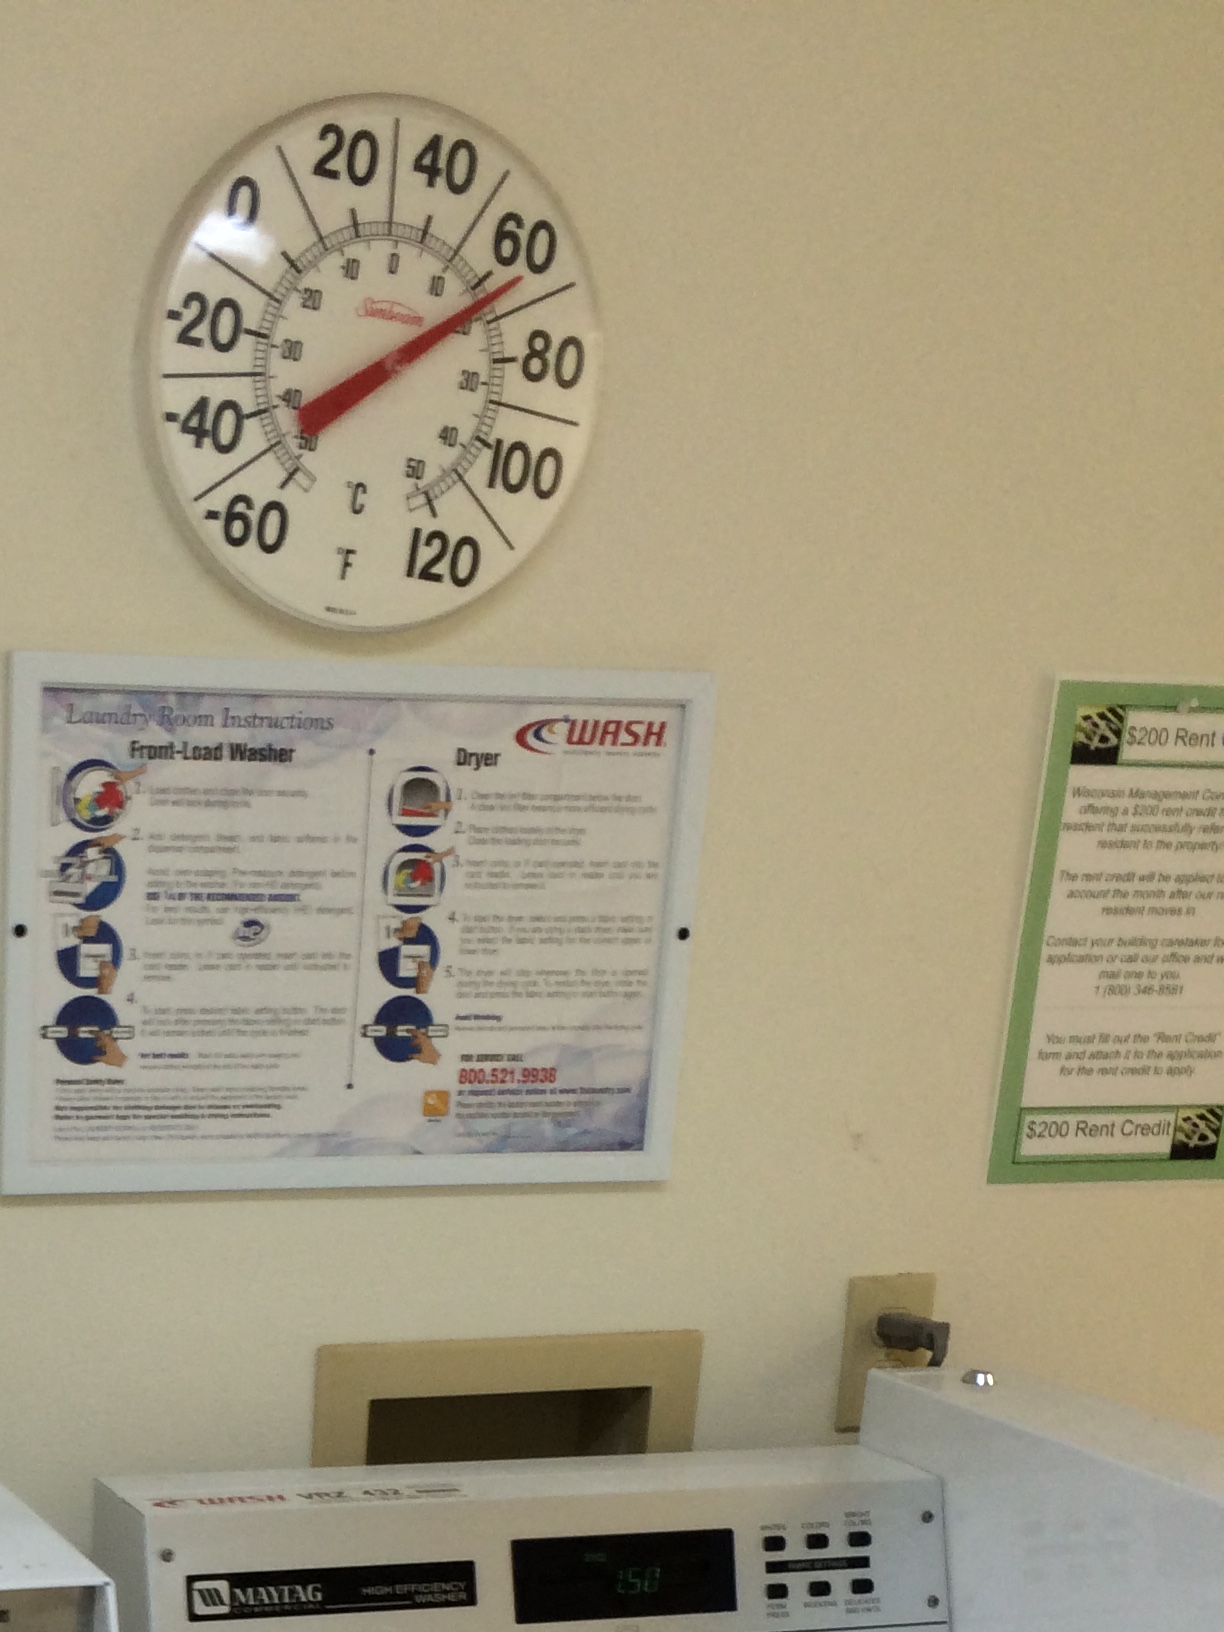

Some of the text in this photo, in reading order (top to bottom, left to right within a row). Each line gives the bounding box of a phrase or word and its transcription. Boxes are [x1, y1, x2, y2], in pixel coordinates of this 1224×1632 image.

[314, 123, 379, 187] 20
[414, 133, 477, 195] 40
[227, 175, 261, 230] 0
[493, 212, 557, 275] 60
[165, 290, 244, 353] -20
[521, 329, 586, 390] 80
[164, 395, 244, 454] -40
[487, 438, 564, 500] 100
[204, 492, 290, 555] -60
[407, 526, 482, 589] 120
[66, 702, 335, 732] Laundry Room Instructions
[566, 718, 666, 748] WASH
[1126, 725, 1216, 748] $200 Rent
[129, 739, 297, 763] Front-Load Washer
[455, 747, 502, 772] Dryer
[458, 1067, 558, 1085] 800.521.9938
[1026, 1118, 1172, 1140] $200 Rent Credit
[232, 1583, 323, 1605] MAYTAG
[361, 1581, 467, 1596] HIGH EFFICIENCY
[414, 1592, 467, 1604] WASHER
